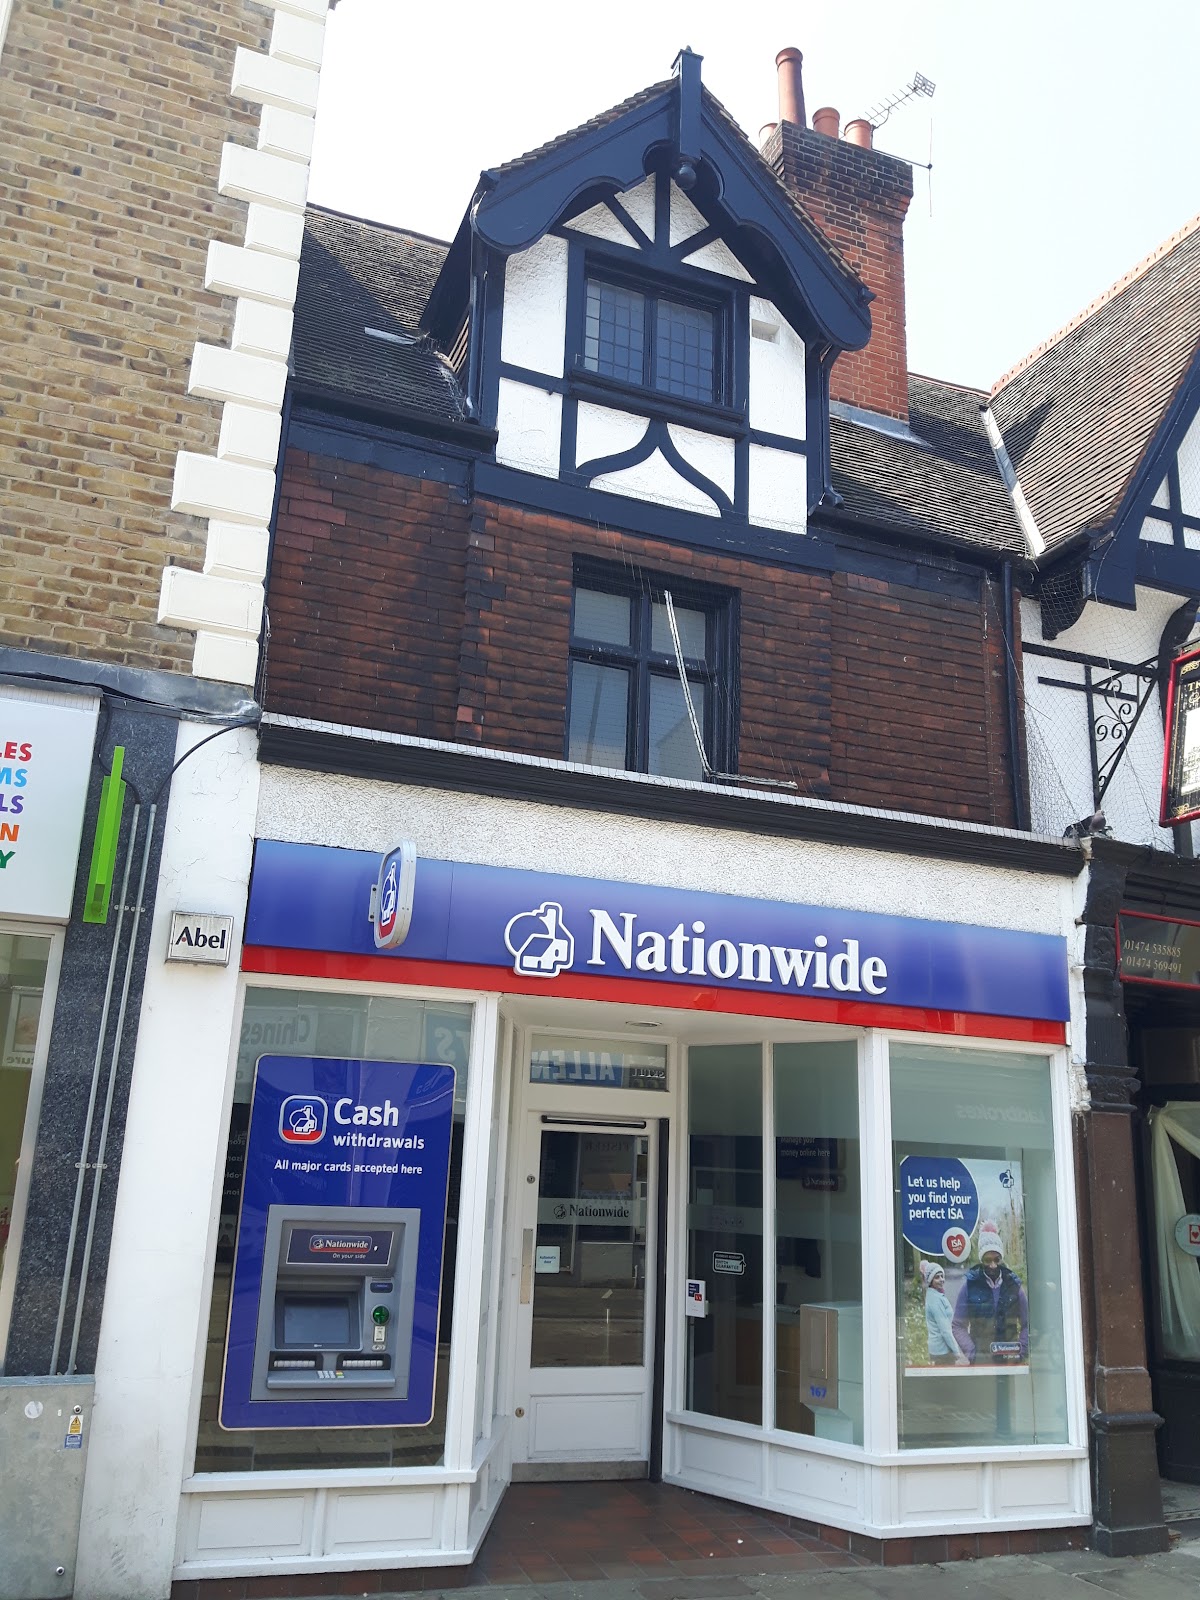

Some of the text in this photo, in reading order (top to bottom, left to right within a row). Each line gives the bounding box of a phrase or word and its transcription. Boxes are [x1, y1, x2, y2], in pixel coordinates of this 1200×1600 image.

[175, 926, 227, 950] Abel
[587, 908, 889, 995] Nationwide
[333, 1097, 399, 1127] Cash
[333, 1132, 425, 1150] withdrawals
[274, 1159, 423, 1175] All major cards accepted here
[907, 1175, 961, 1191] Let us help
[908, 1191, 972, 1207] you find your
[569, 1204, 630, 1218] Nationwide
[909, 1206, 964, 1221] perfect ISA
[325, 1239, 369, 1249] Nationwide
[951, 1238, 963, 1248] ISA
